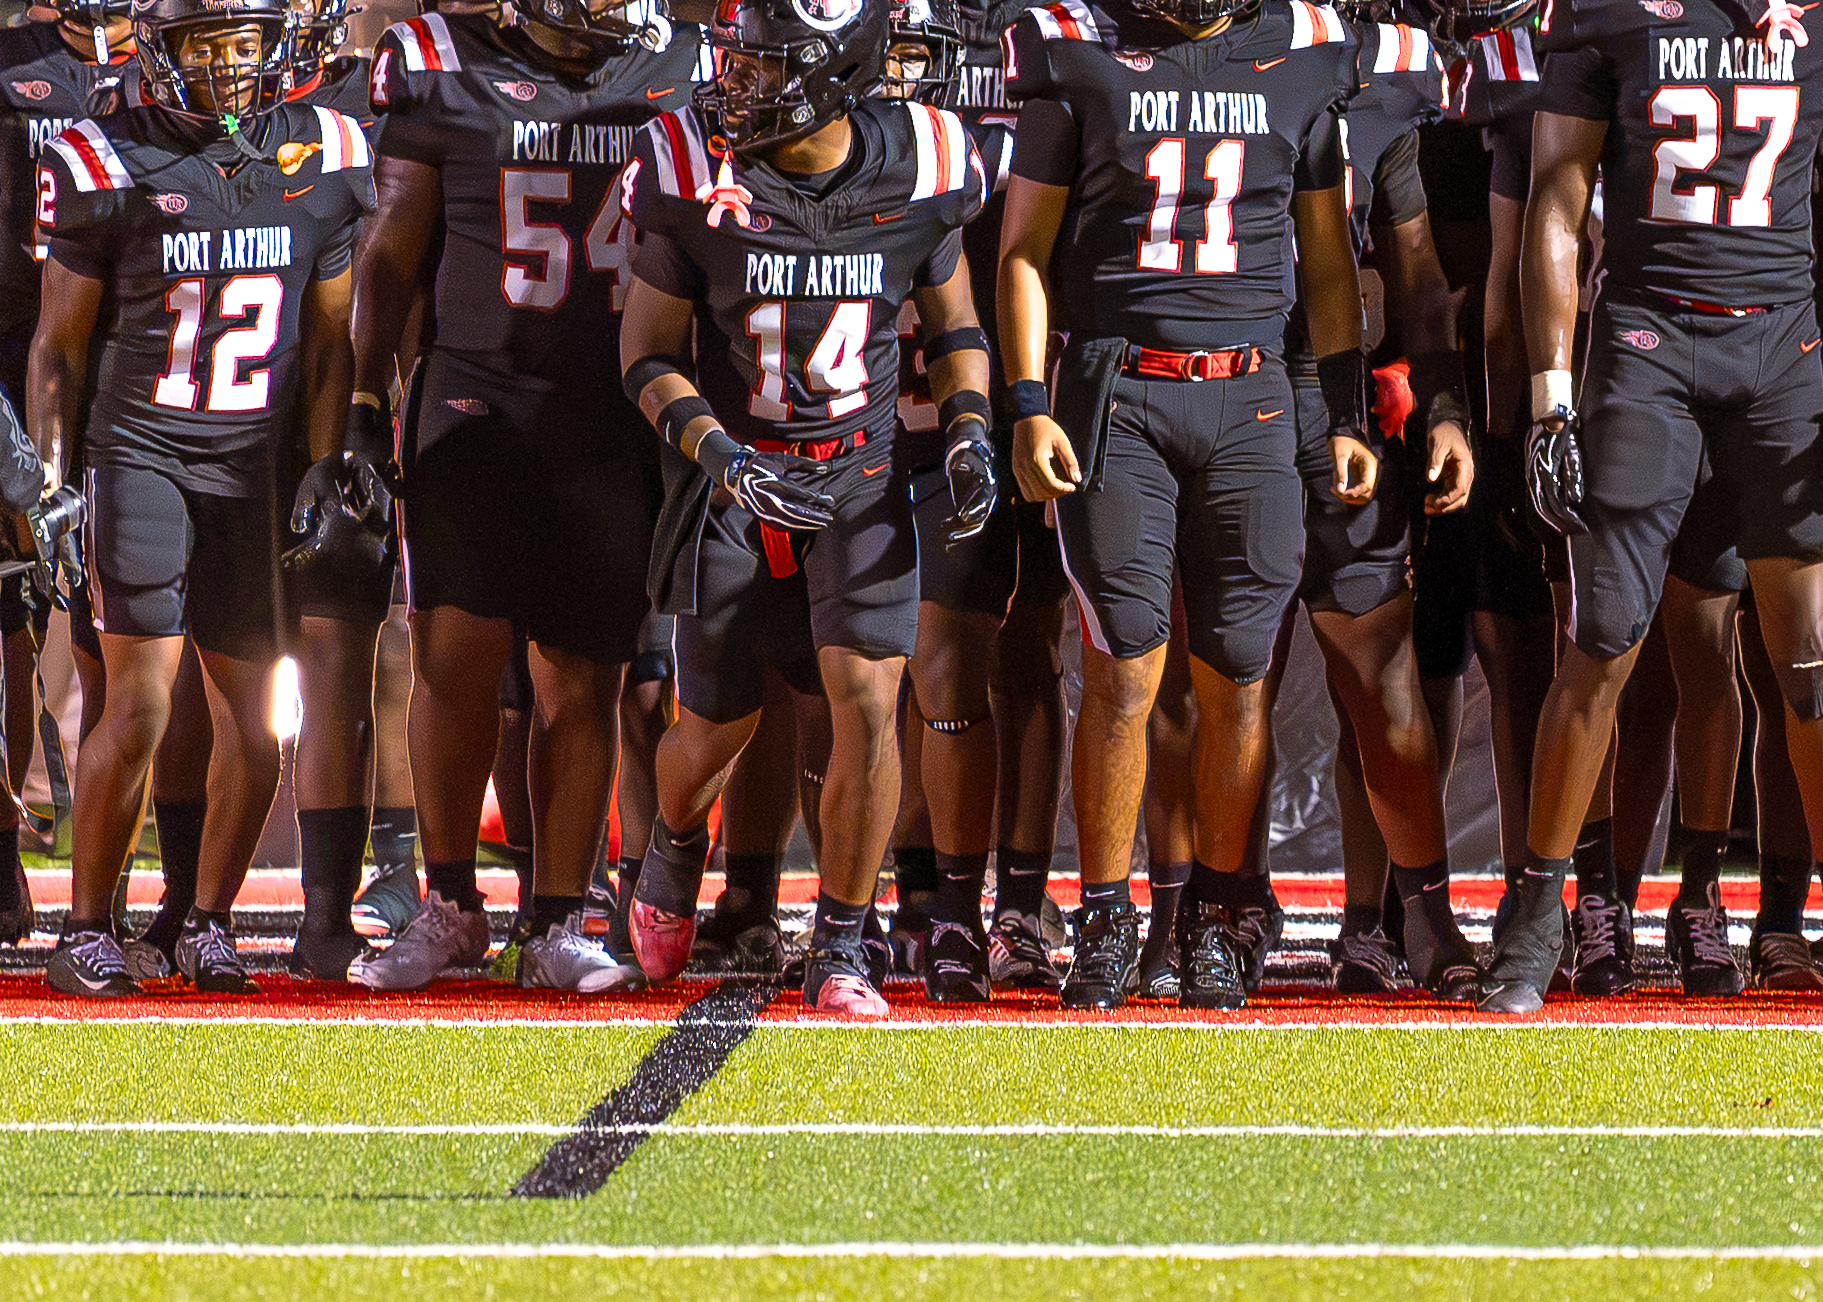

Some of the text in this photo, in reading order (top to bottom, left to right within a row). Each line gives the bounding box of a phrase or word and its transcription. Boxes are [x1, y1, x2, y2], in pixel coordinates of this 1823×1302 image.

[1657, 37, 1710, 81] PORT
[513, 120, 561, 161] PORT
[1128, 91, 1270, 135] PORT ARTHUR
[1648, 84, 1801, 229] 27
[501, 167, 635, 314] 54
[1136, 137, 1246, 274] 11
[162, 226, 292, 273] PORT ARTHUR
[745, 253, 884, 296] PORT ARTHUR
[152, 273, 285, 411] 12
[745, 298, 872, 421] 14
